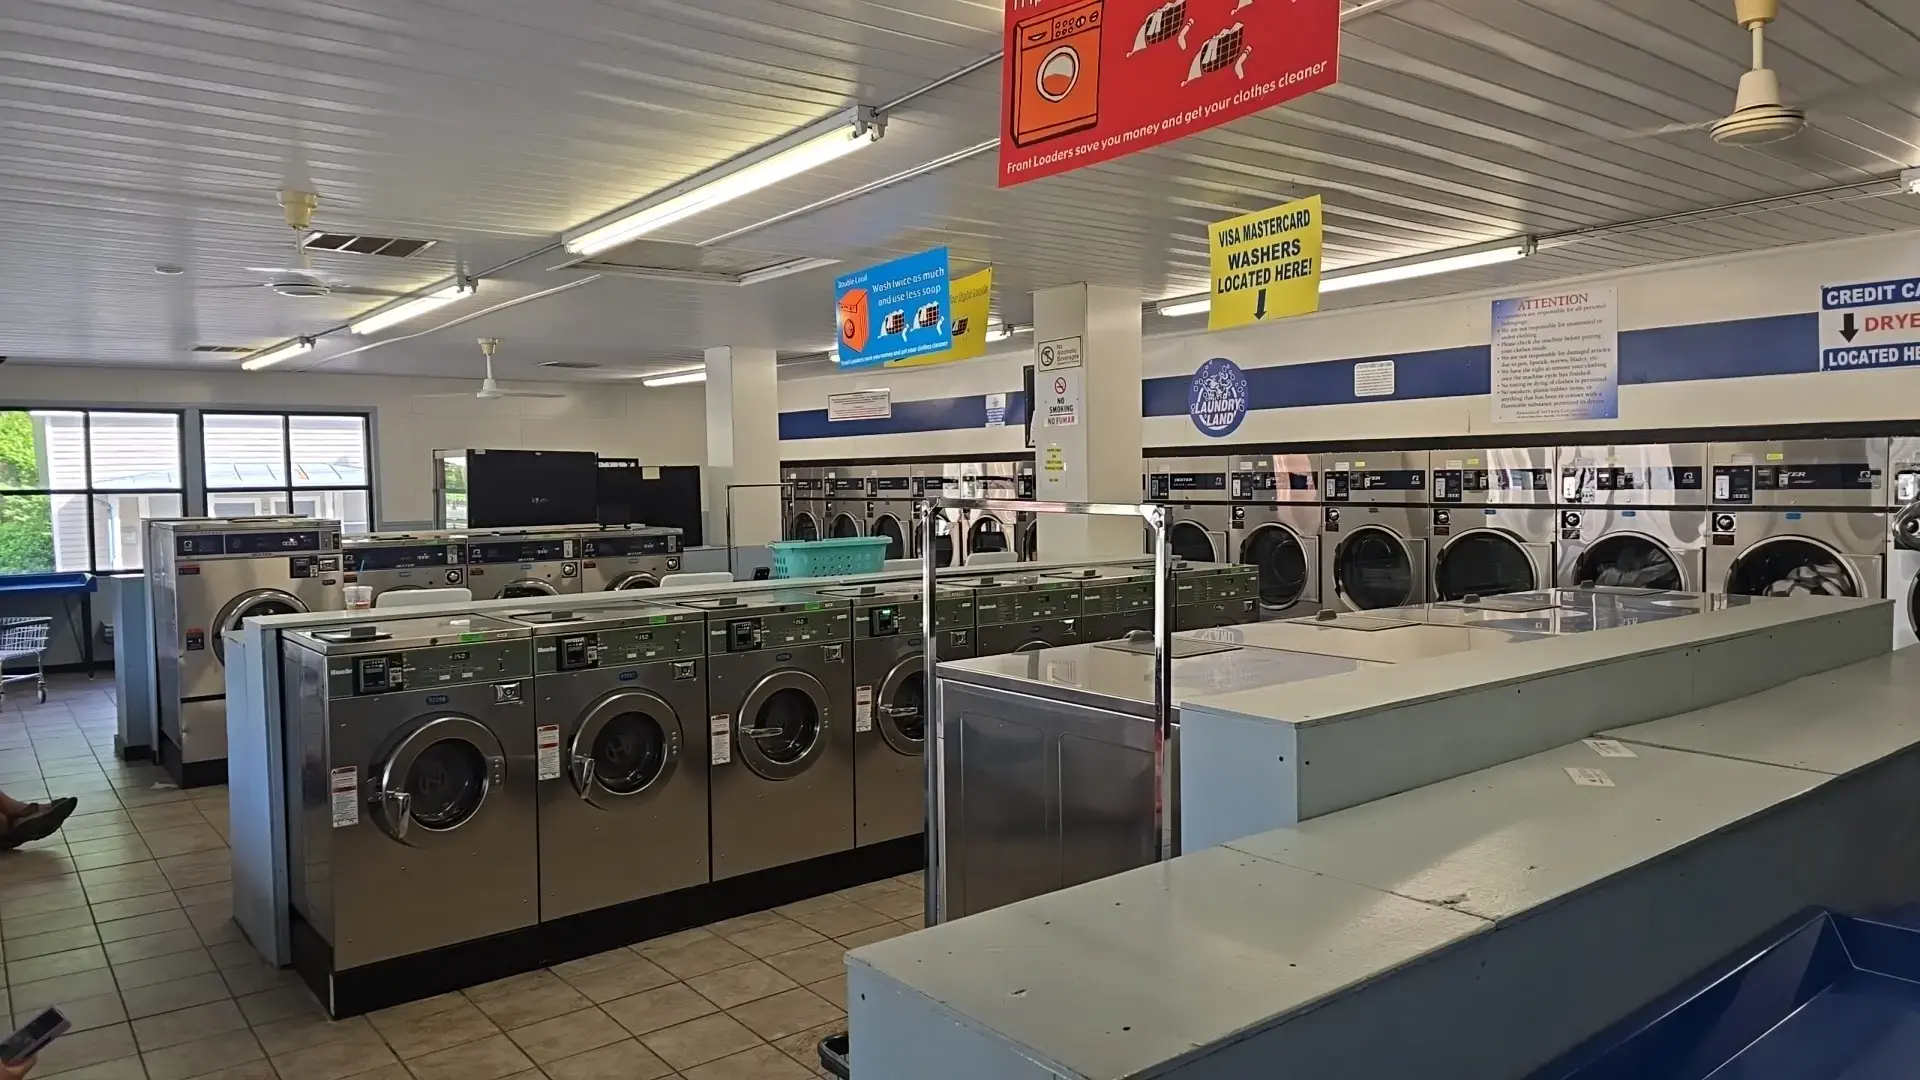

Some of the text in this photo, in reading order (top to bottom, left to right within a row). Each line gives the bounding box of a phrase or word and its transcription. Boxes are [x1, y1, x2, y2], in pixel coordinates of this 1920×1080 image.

[1007, 60, 1327, 174] Front Loaders save you money and get your clothes cleaner
[1219, 209, 1311, 248] VISA MASTERCARD
[1228, 238, 1301, 270] WASHERS
[872, 266, 945, 293] Wash twice as much
[1217, 258, 1313, 294] LOCATED HERE!
[878, 284, 942, 307] and use less soap
[1517, 293, 1588, 311] ATTENTION
[1826, 284, 1896, 306] CREDIT
[1828, 347, 1900, 367] LOCATED
[1049, 404, 1074, 414] SMOKING
[1056, 396, 1065, 404] NO
[1194, 397, 1241, 414] LAUNDRY
[1047, 415, 1075, 425] NO FUMAR
[1206, 411, 1235, 427] LAND
